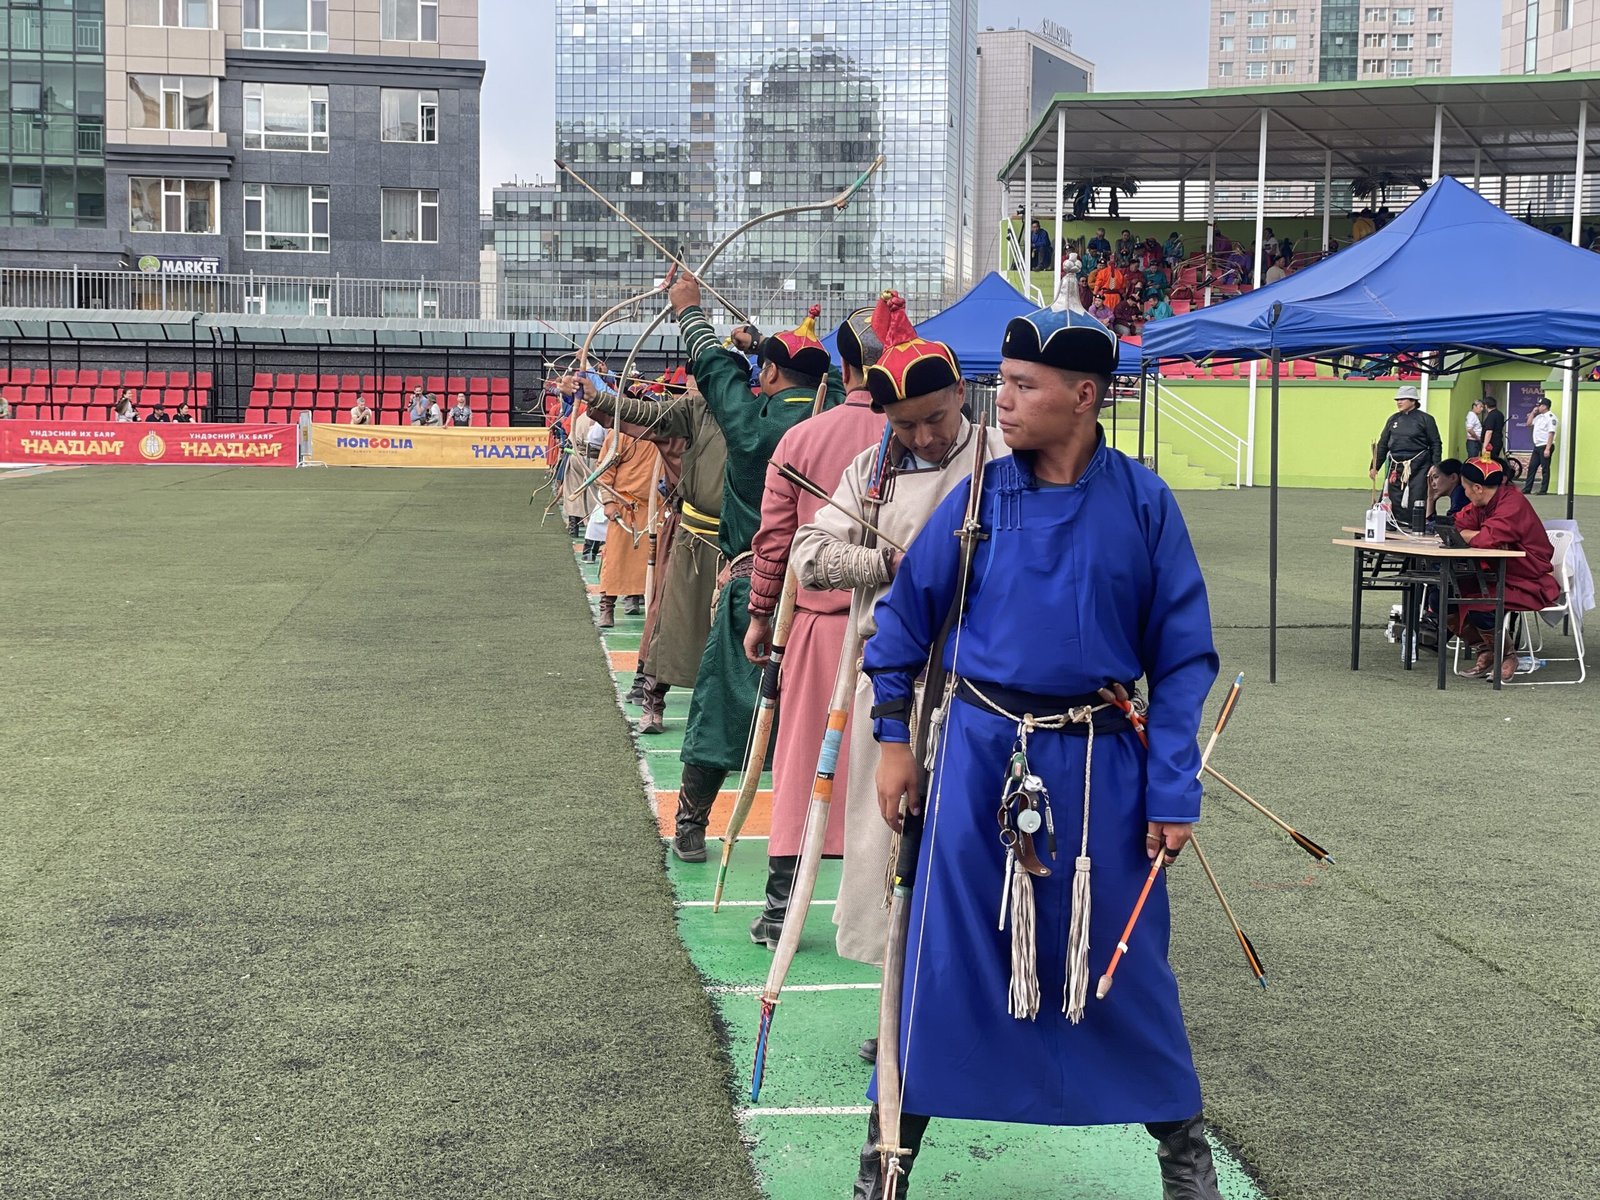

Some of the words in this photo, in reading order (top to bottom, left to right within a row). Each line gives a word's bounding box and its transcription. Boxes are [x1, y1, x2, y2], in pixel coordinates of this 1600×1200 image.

[162, 260, 218, 274] MARKET
[79, 430, 92, 438] ИХ
[94, 430, 116, 438] БАЯР
[20, 440, 124, 456] НААДАМ
[180, 442, 282, 458] НААДАМ
[336, 437, 413, 449] MONGOLIA
[472, 444, 548, 459] НААДА
